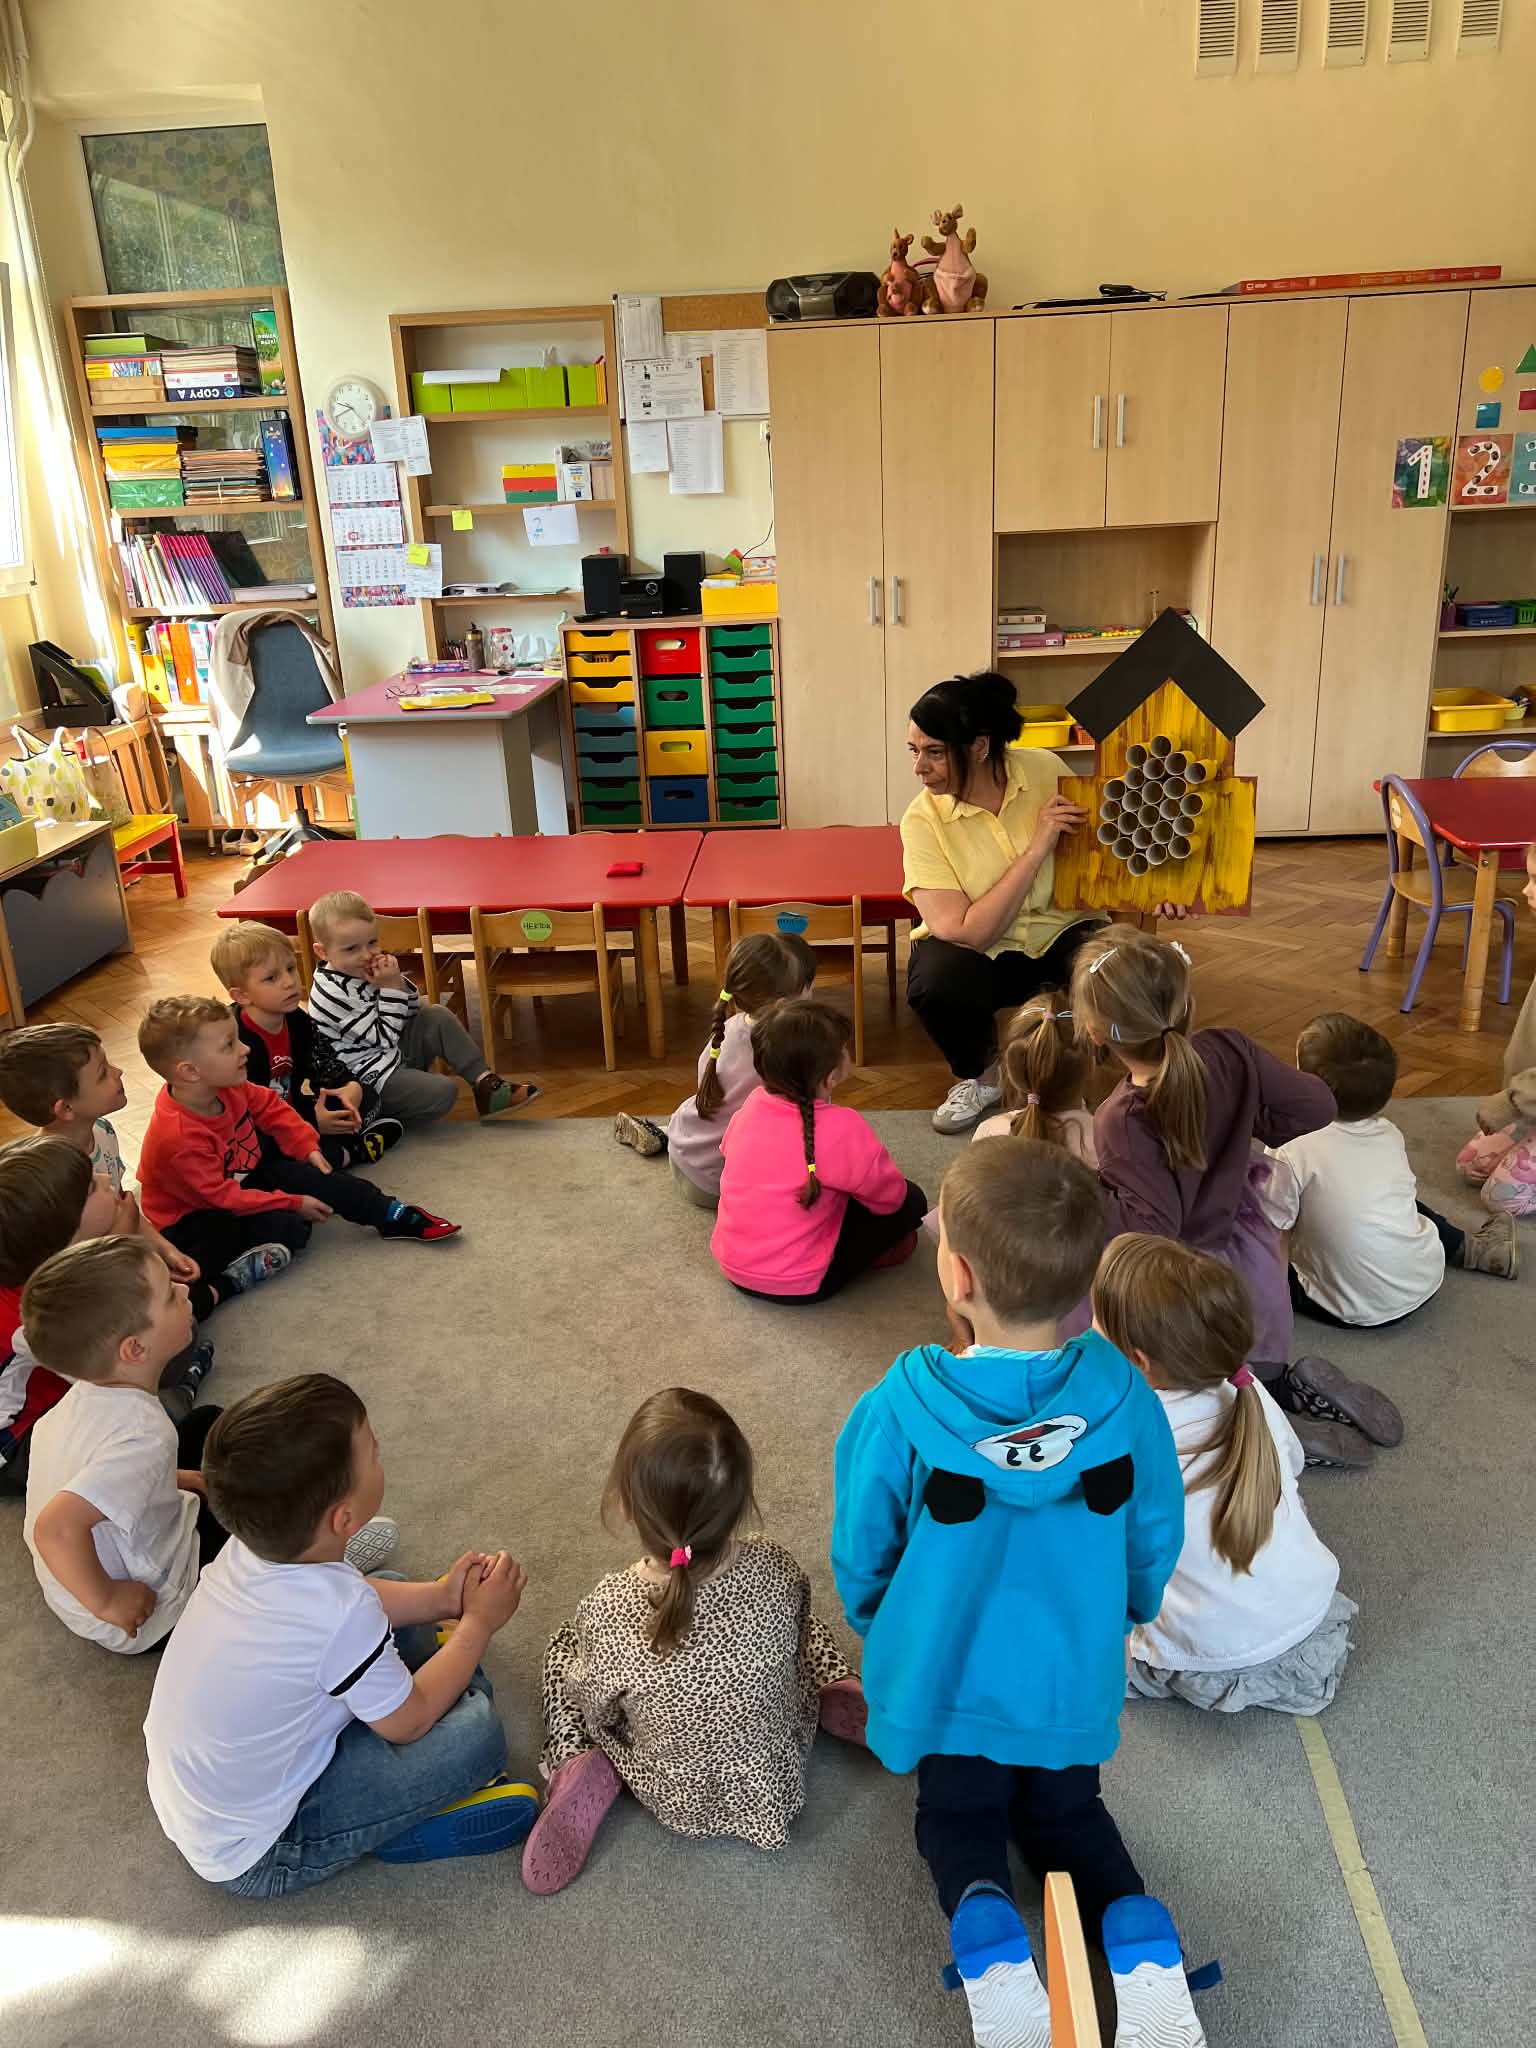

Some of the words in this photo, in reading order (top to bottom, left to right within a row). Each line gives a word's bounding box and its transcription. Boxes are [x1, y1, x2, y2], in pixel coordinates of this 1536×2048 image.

[190, 388, 220, 399] COPY
[1407, 445, 1433, 498] 1
[1461, 441, 1501, 497] 2
